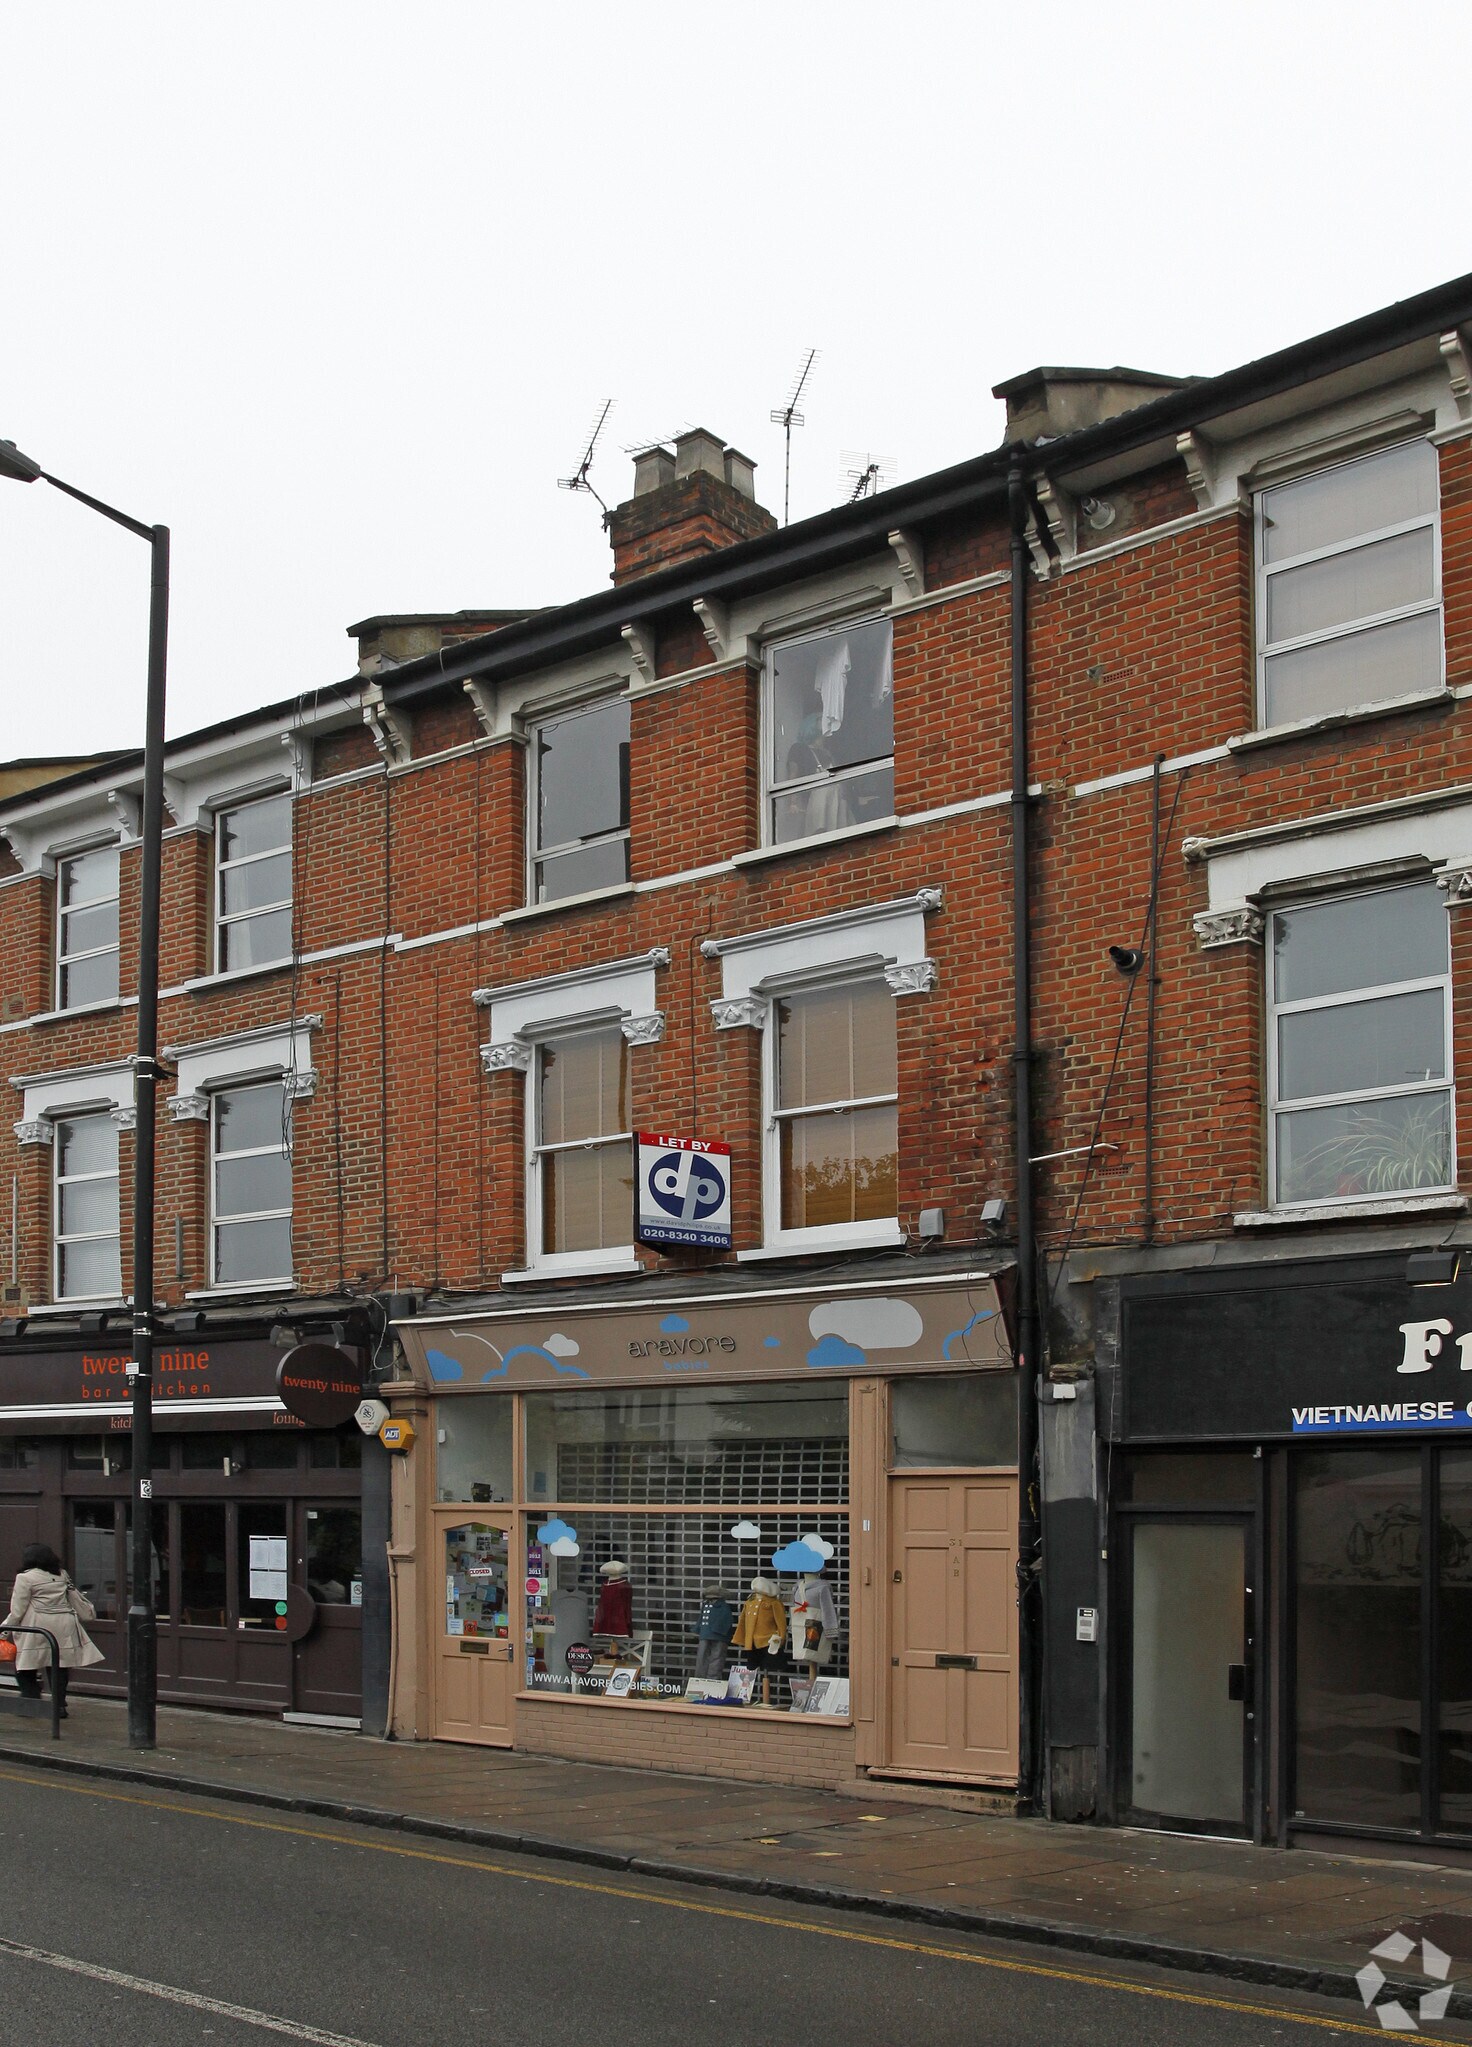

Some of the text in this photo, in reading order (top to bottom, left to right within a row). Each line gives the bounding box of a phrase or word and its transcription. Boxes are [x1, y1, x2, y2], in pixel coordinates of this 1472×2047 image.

[659, 1136, 711, 1152] LET BY
[643, 1228, 728, 1245] 020-8340 3406
[627, 1335, 736, 1358] aravore
[82, 1354, 134, 1376] twen
[160, 1347, 209, 1372] nine
[82, 1380, 211, 1398] bar itchen
[283, 1375, 360, 1394] twenty nine
[1291, 1401, 1454, 1425] VIETNAMESE
[385, 1429, 399, 1439] ADT
[953, 1556, 960, 1564] A
[567, 1652, 593, 1660] DESIGN
